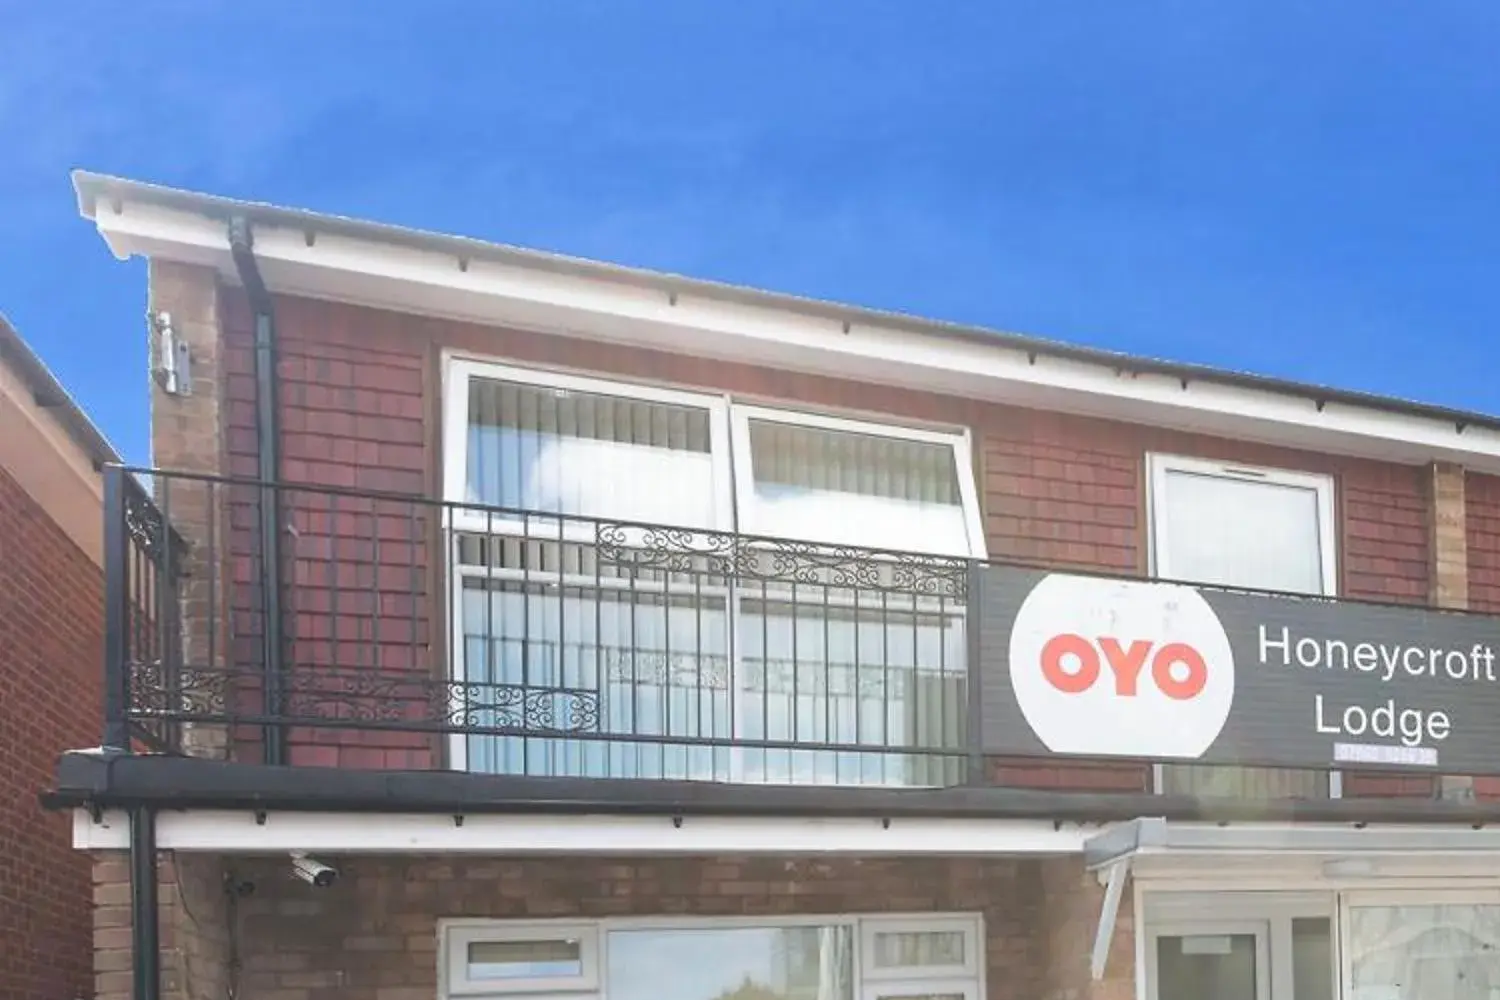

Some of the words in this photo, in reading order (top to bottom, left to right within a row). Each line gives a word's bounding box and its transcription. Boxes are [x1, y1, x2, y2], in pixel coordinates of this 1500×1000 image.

[1040, 632, 1208, 701] OYO
[1258, 624, 1498, 683] Honeycroft
[1314, 694, 1452, 747] Lodge
